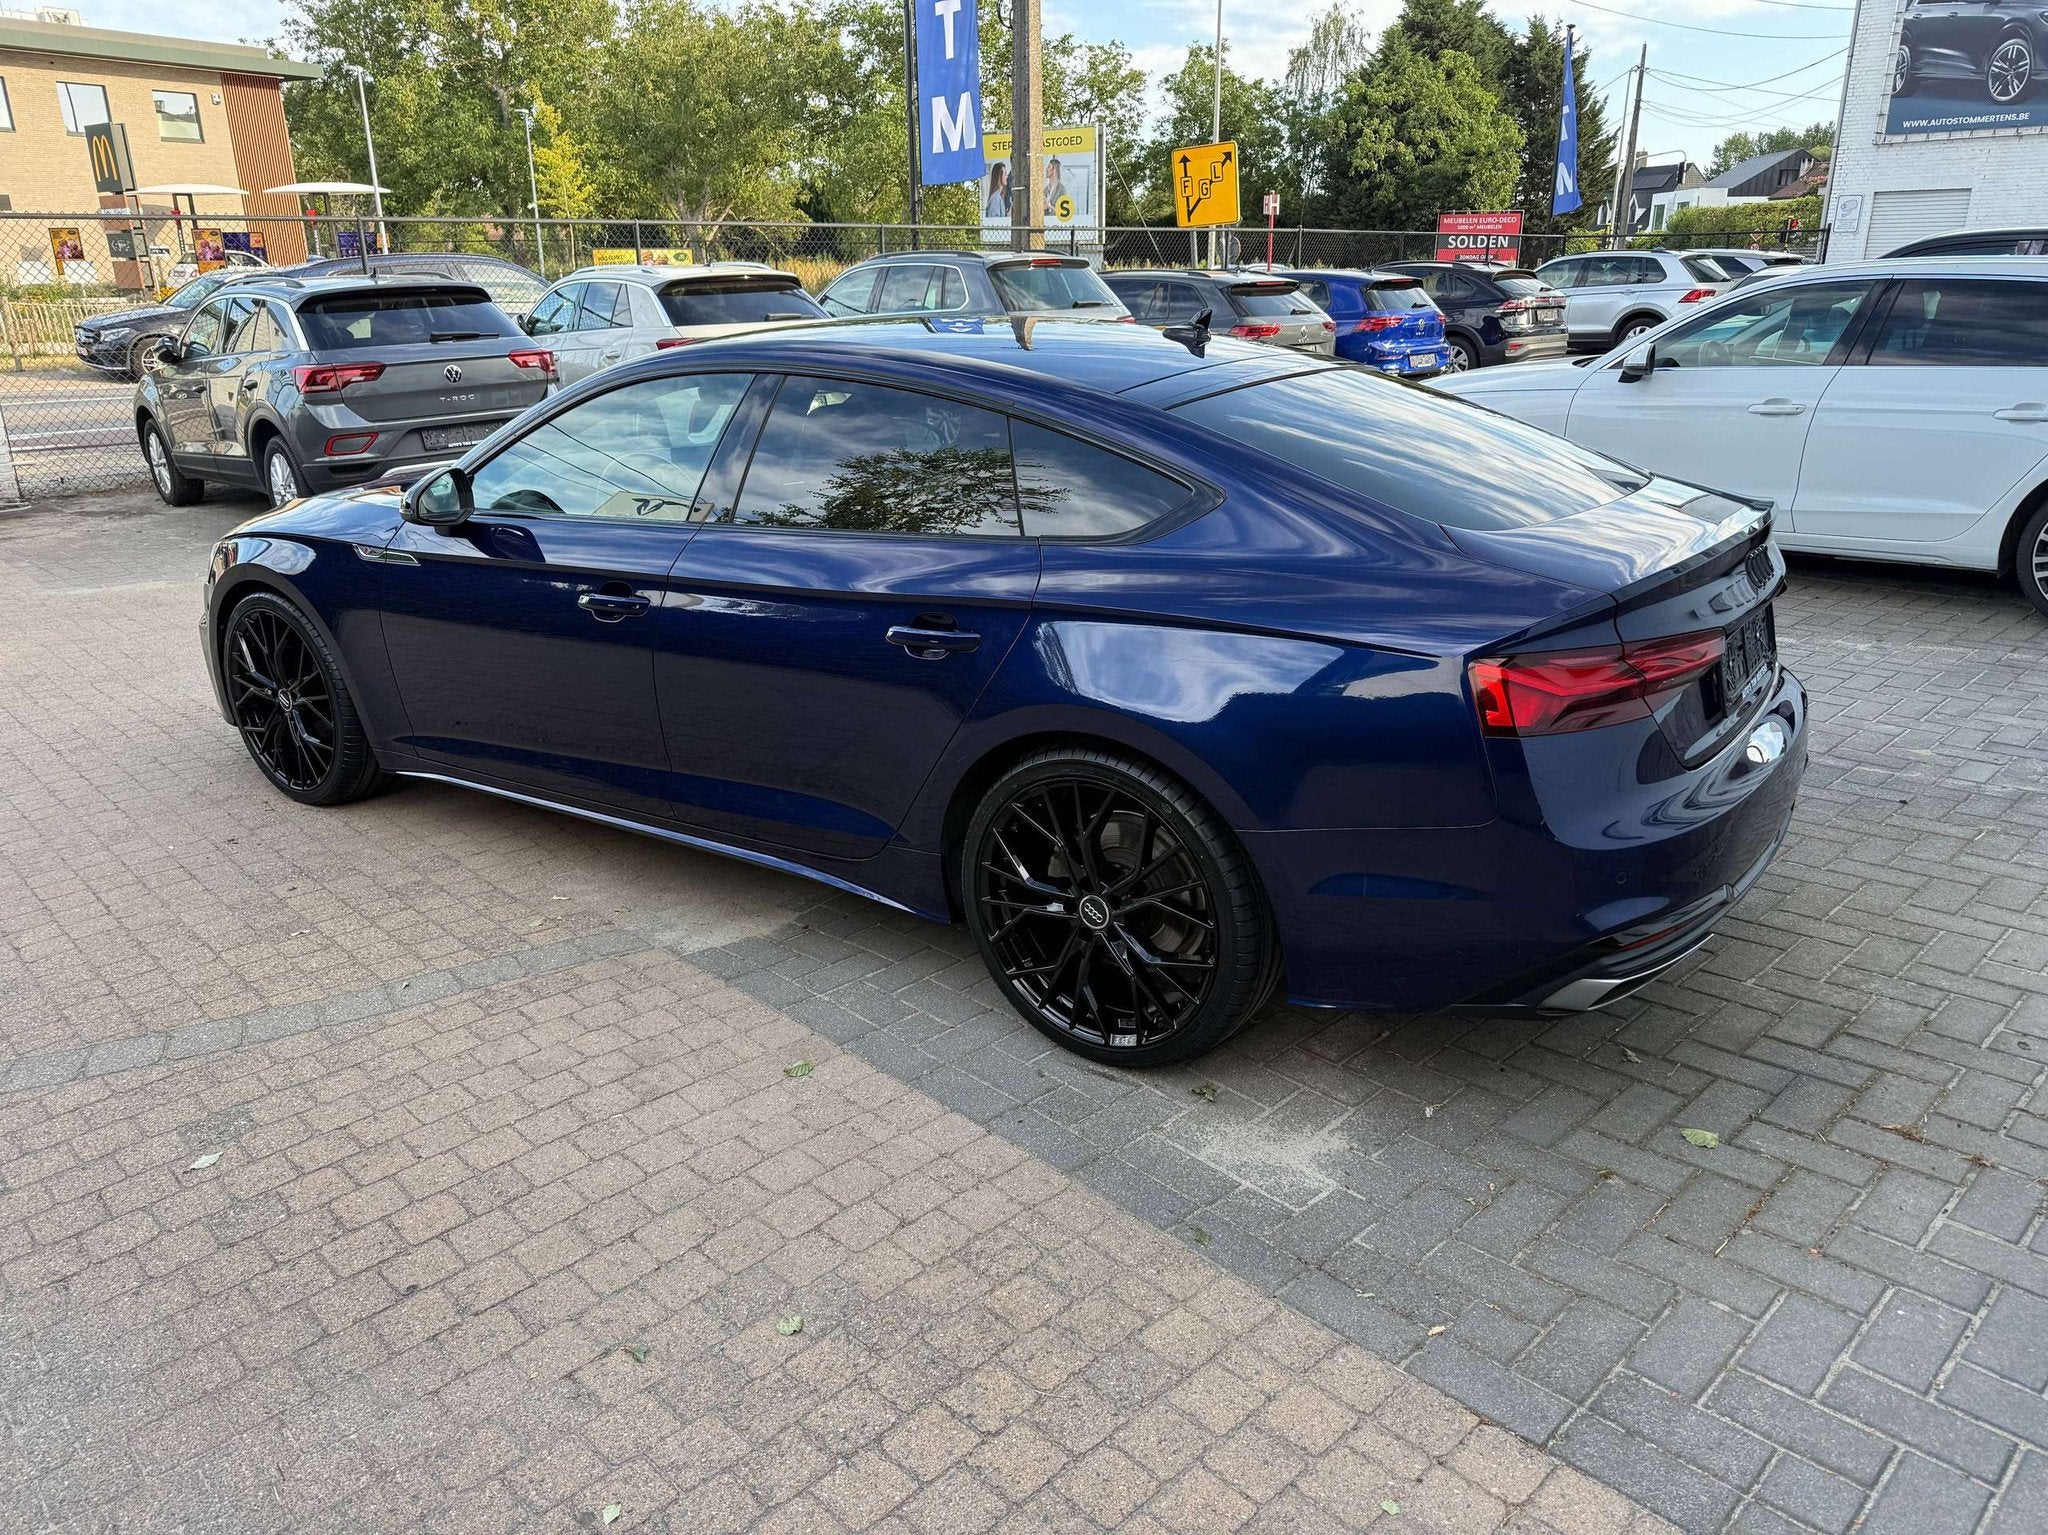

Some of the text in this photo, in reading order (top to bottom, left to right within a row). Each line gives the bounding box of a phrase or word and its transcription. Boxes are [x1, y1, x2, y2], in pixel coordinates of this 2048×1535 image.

[1902, 112, 2031, 128] WWW.AUTOSTOMMERTENS.BE
[991, 135, 1083, 151] STER STGOED
[1213, 165, 1221, 179] L
[1183, 180, 1190, 194] F
[1201, 181, 1209, 196] G
[1059, 199, 1071, 218] S
[1443, 216, 1517, 225] MEUBELEN EURO-DECO
[1447, 235, 1509, 249] SOLDEN
